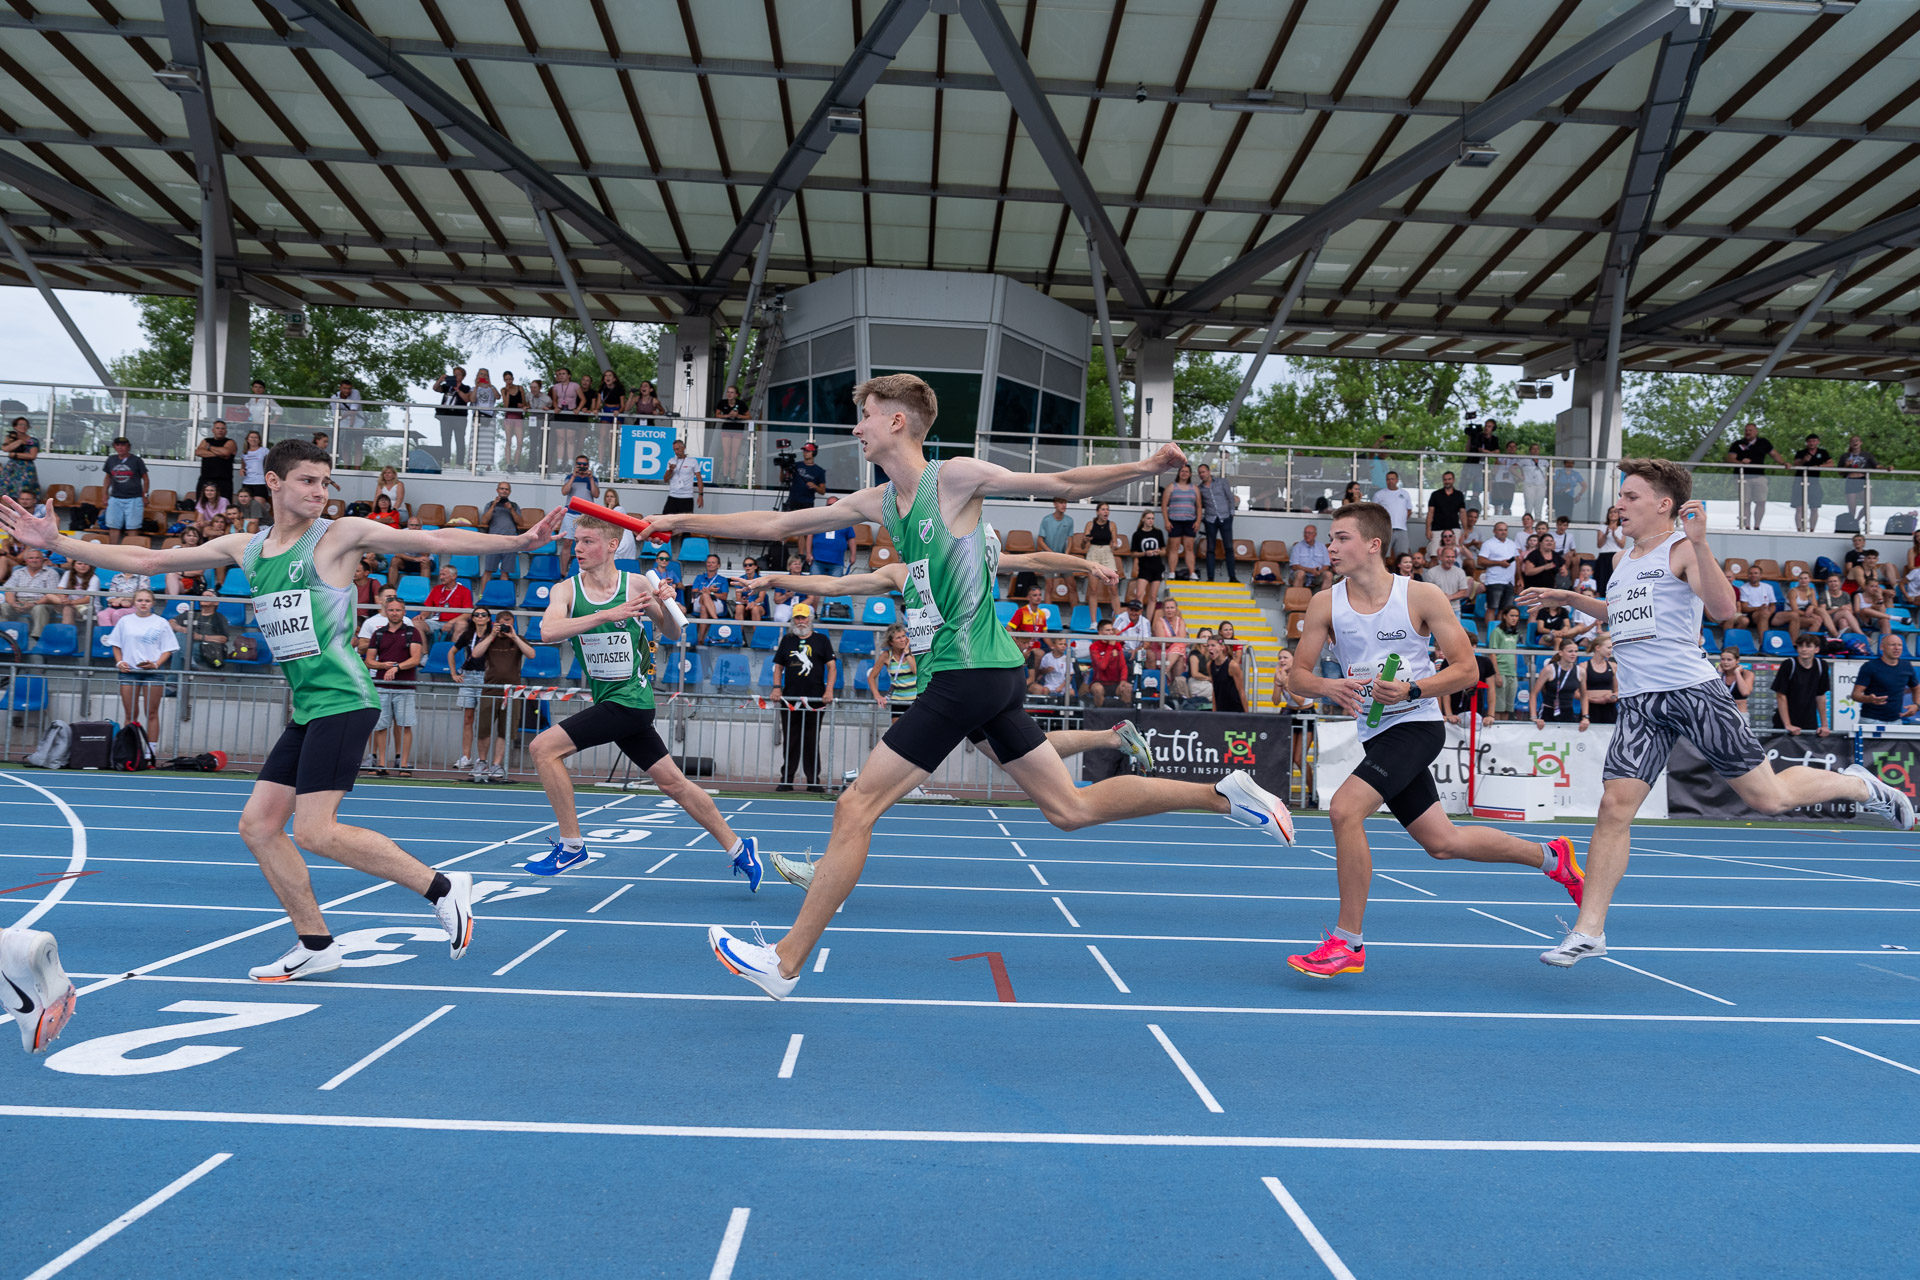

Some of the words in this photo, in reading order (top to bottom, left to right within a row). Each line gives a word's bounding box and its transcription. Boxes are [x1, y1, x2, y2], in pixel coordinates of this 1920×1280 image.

[631, 429, 667, 439] SEKTOR
[633, 440, 661, 475] B
[912, 564, 926, 580] 435
[273, 593, 302, 609] 437
[1627, 586, 1647, 601] 264
[1607, 605, 1653, 627] WYSOCKI
[606, 635, 627, 646] 176
[585, 651, 631, 664] WOJTASZEK
[1377, 660, 1404, 673] 22
[333, 926, 451, 968] 3
[43, 998, 323, 1077] 2
